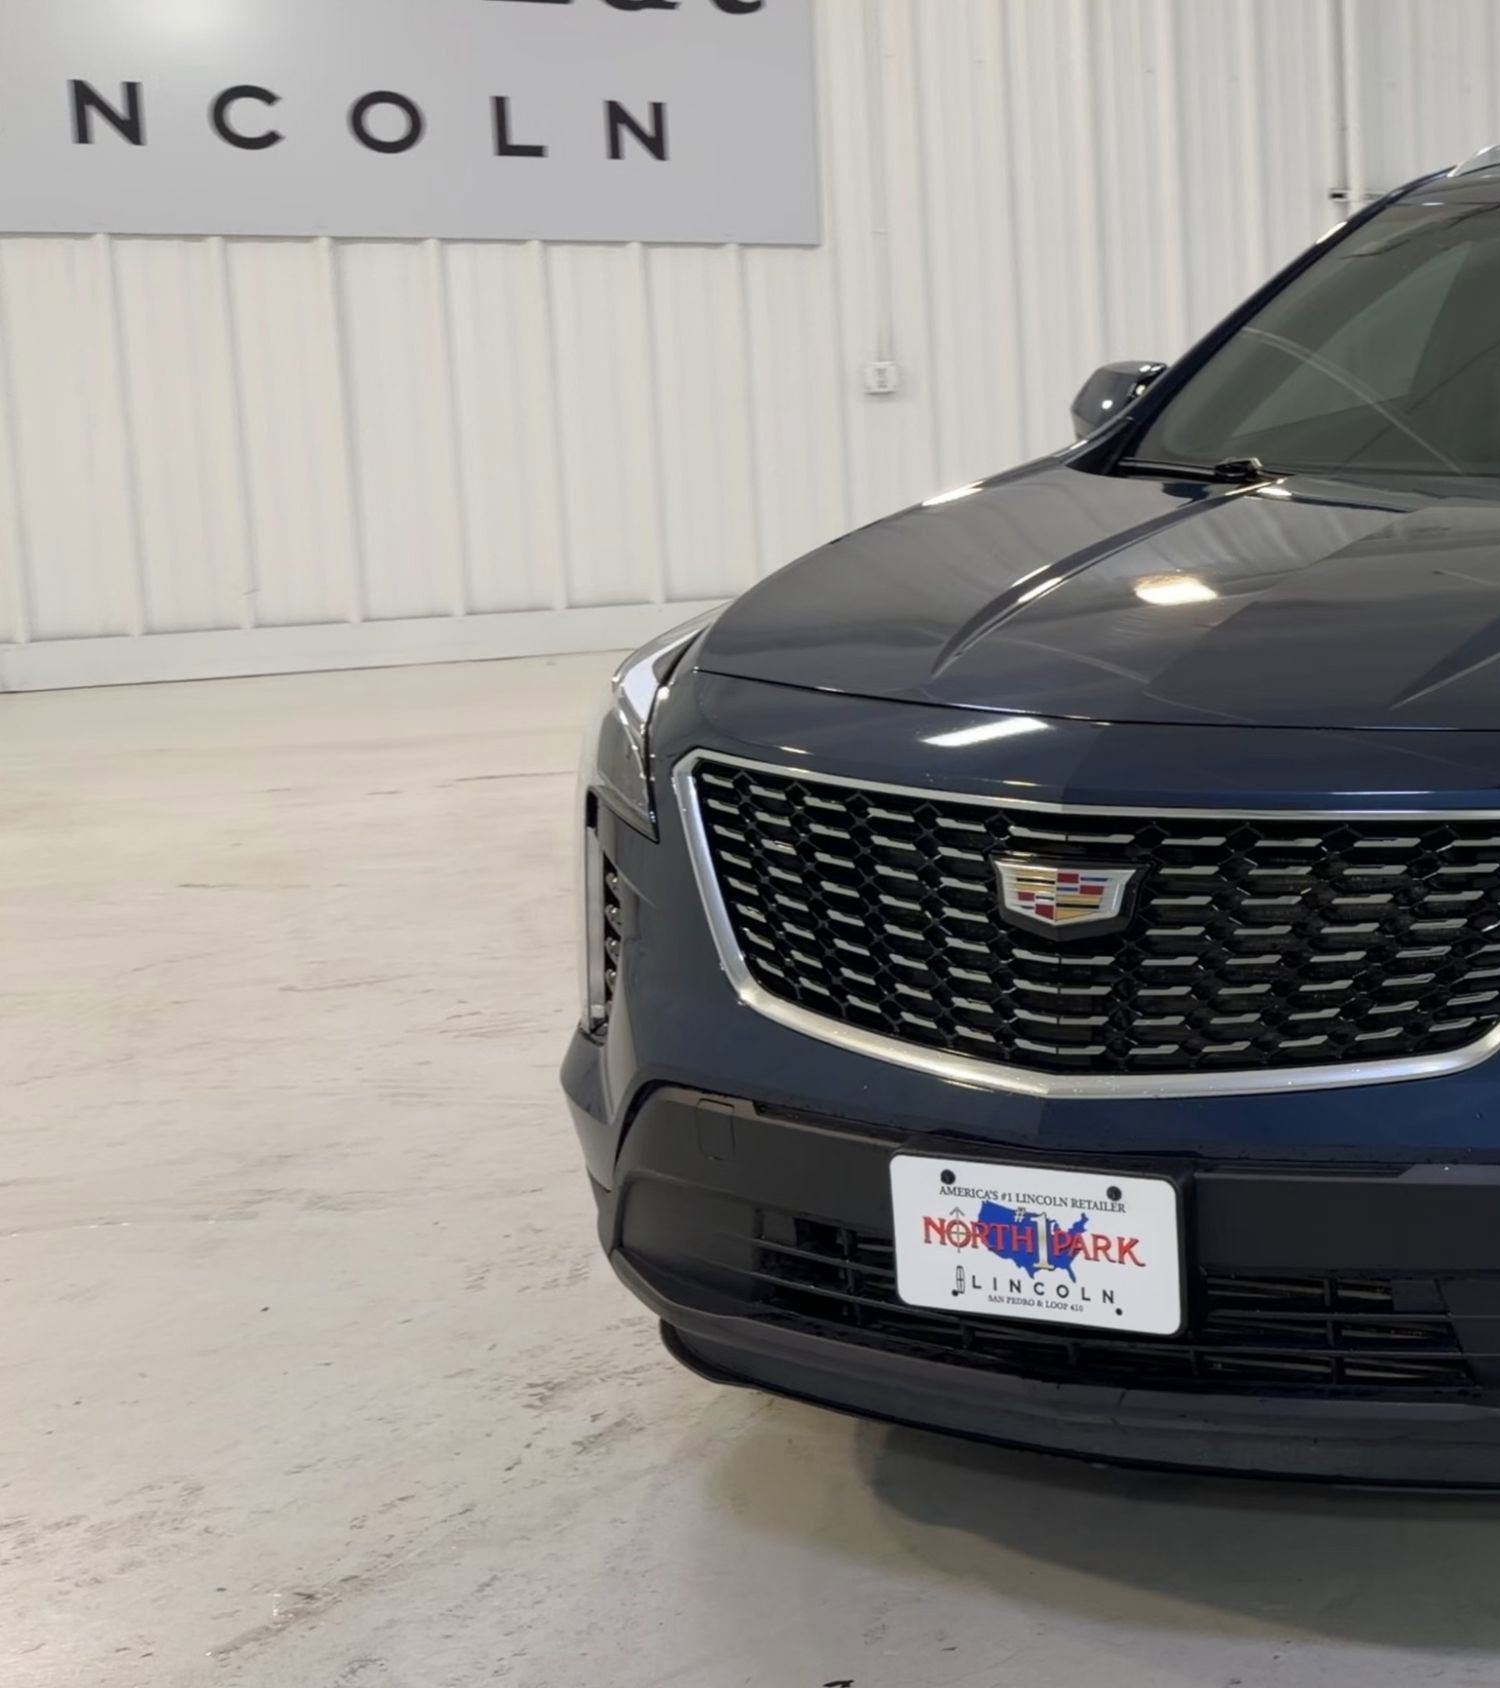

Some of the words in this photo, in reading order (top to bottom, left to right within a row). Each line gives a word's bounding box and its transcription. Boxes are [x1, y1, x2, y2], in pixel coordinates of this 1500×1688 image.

[939, 1185, 998, 1201] AMERICA'S
[1001, 1192, 1012, 1203] #1
[1015, 1193, 1069, 1208] LINCOLN
[1071, 1198, 1127, 1214] RETAILER
[922, 1215, 1034, 1254] NORTH
[1051, 1228, 1146, 1267] PARK
[971, 1274, 1115, 1305] LINCOLN
[988, 1294, 1005, 1304] SAN
[1006, 1296, 1035, 1307] PEDRO
[1036, 1300, 1044, 1308] &
[1045, 1300, 1069, 1311] LOOP
